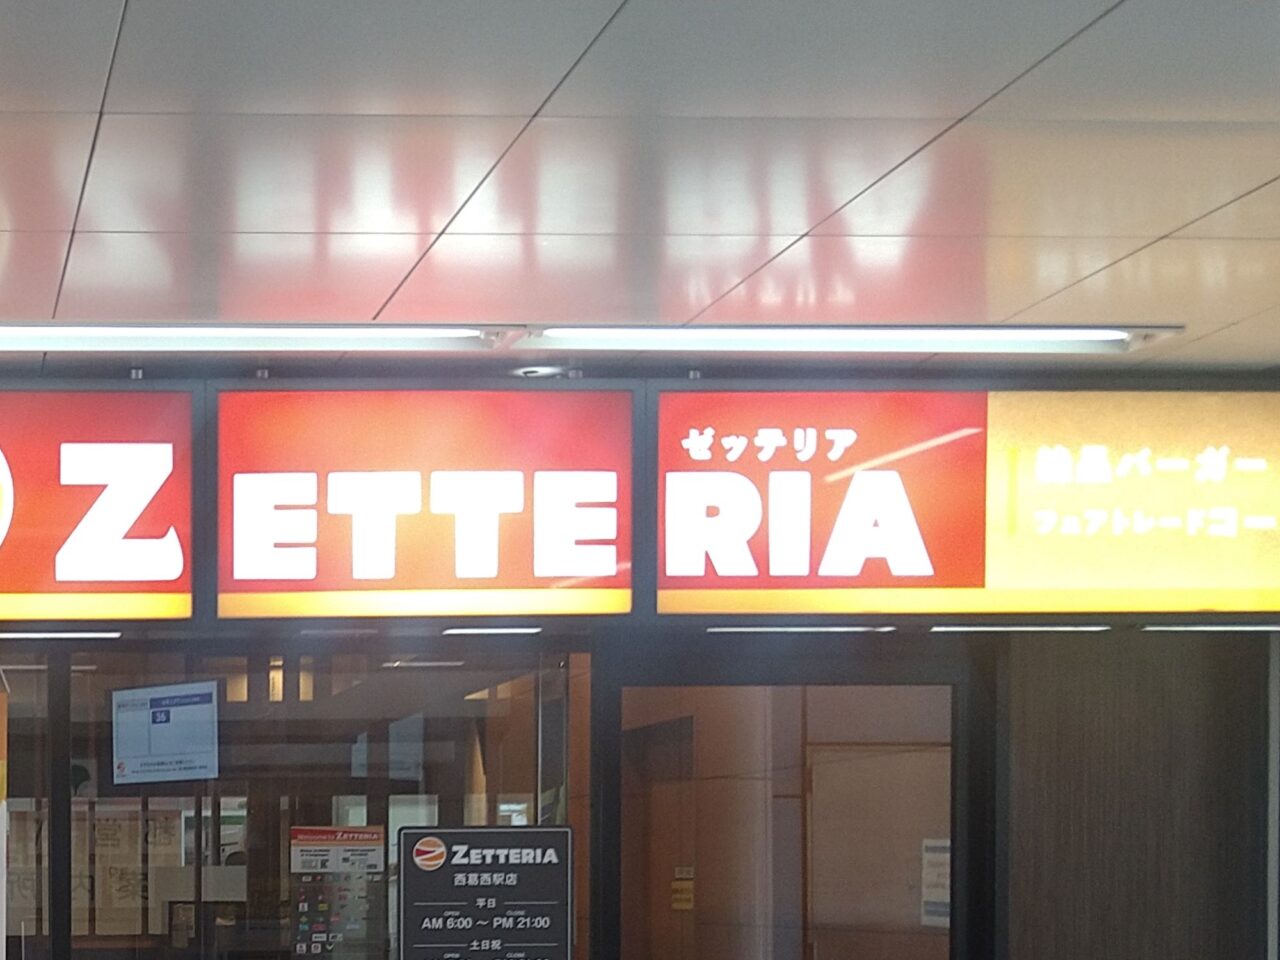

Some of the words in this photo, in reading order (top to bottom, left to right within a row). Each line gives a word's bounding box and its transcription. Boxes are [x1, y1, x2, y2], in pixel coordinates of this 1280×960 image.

[681, 427, 858, 462] ゼッテリア
[54, 441, 935, 581] ZETTERIA
[451, 844, 559, 864] ZETTERIA
[454, 872, 518, 886] 西葛西駅店
[475, 898, 497, 909] 平日
[421, 918, 443, 929] AM
[446, 917, 473, 929] 6:00
[493, 917, 514, 929] PM
[516, 917, 550, 929] 21:00
[469, 940, 501, 950] 土日祝
